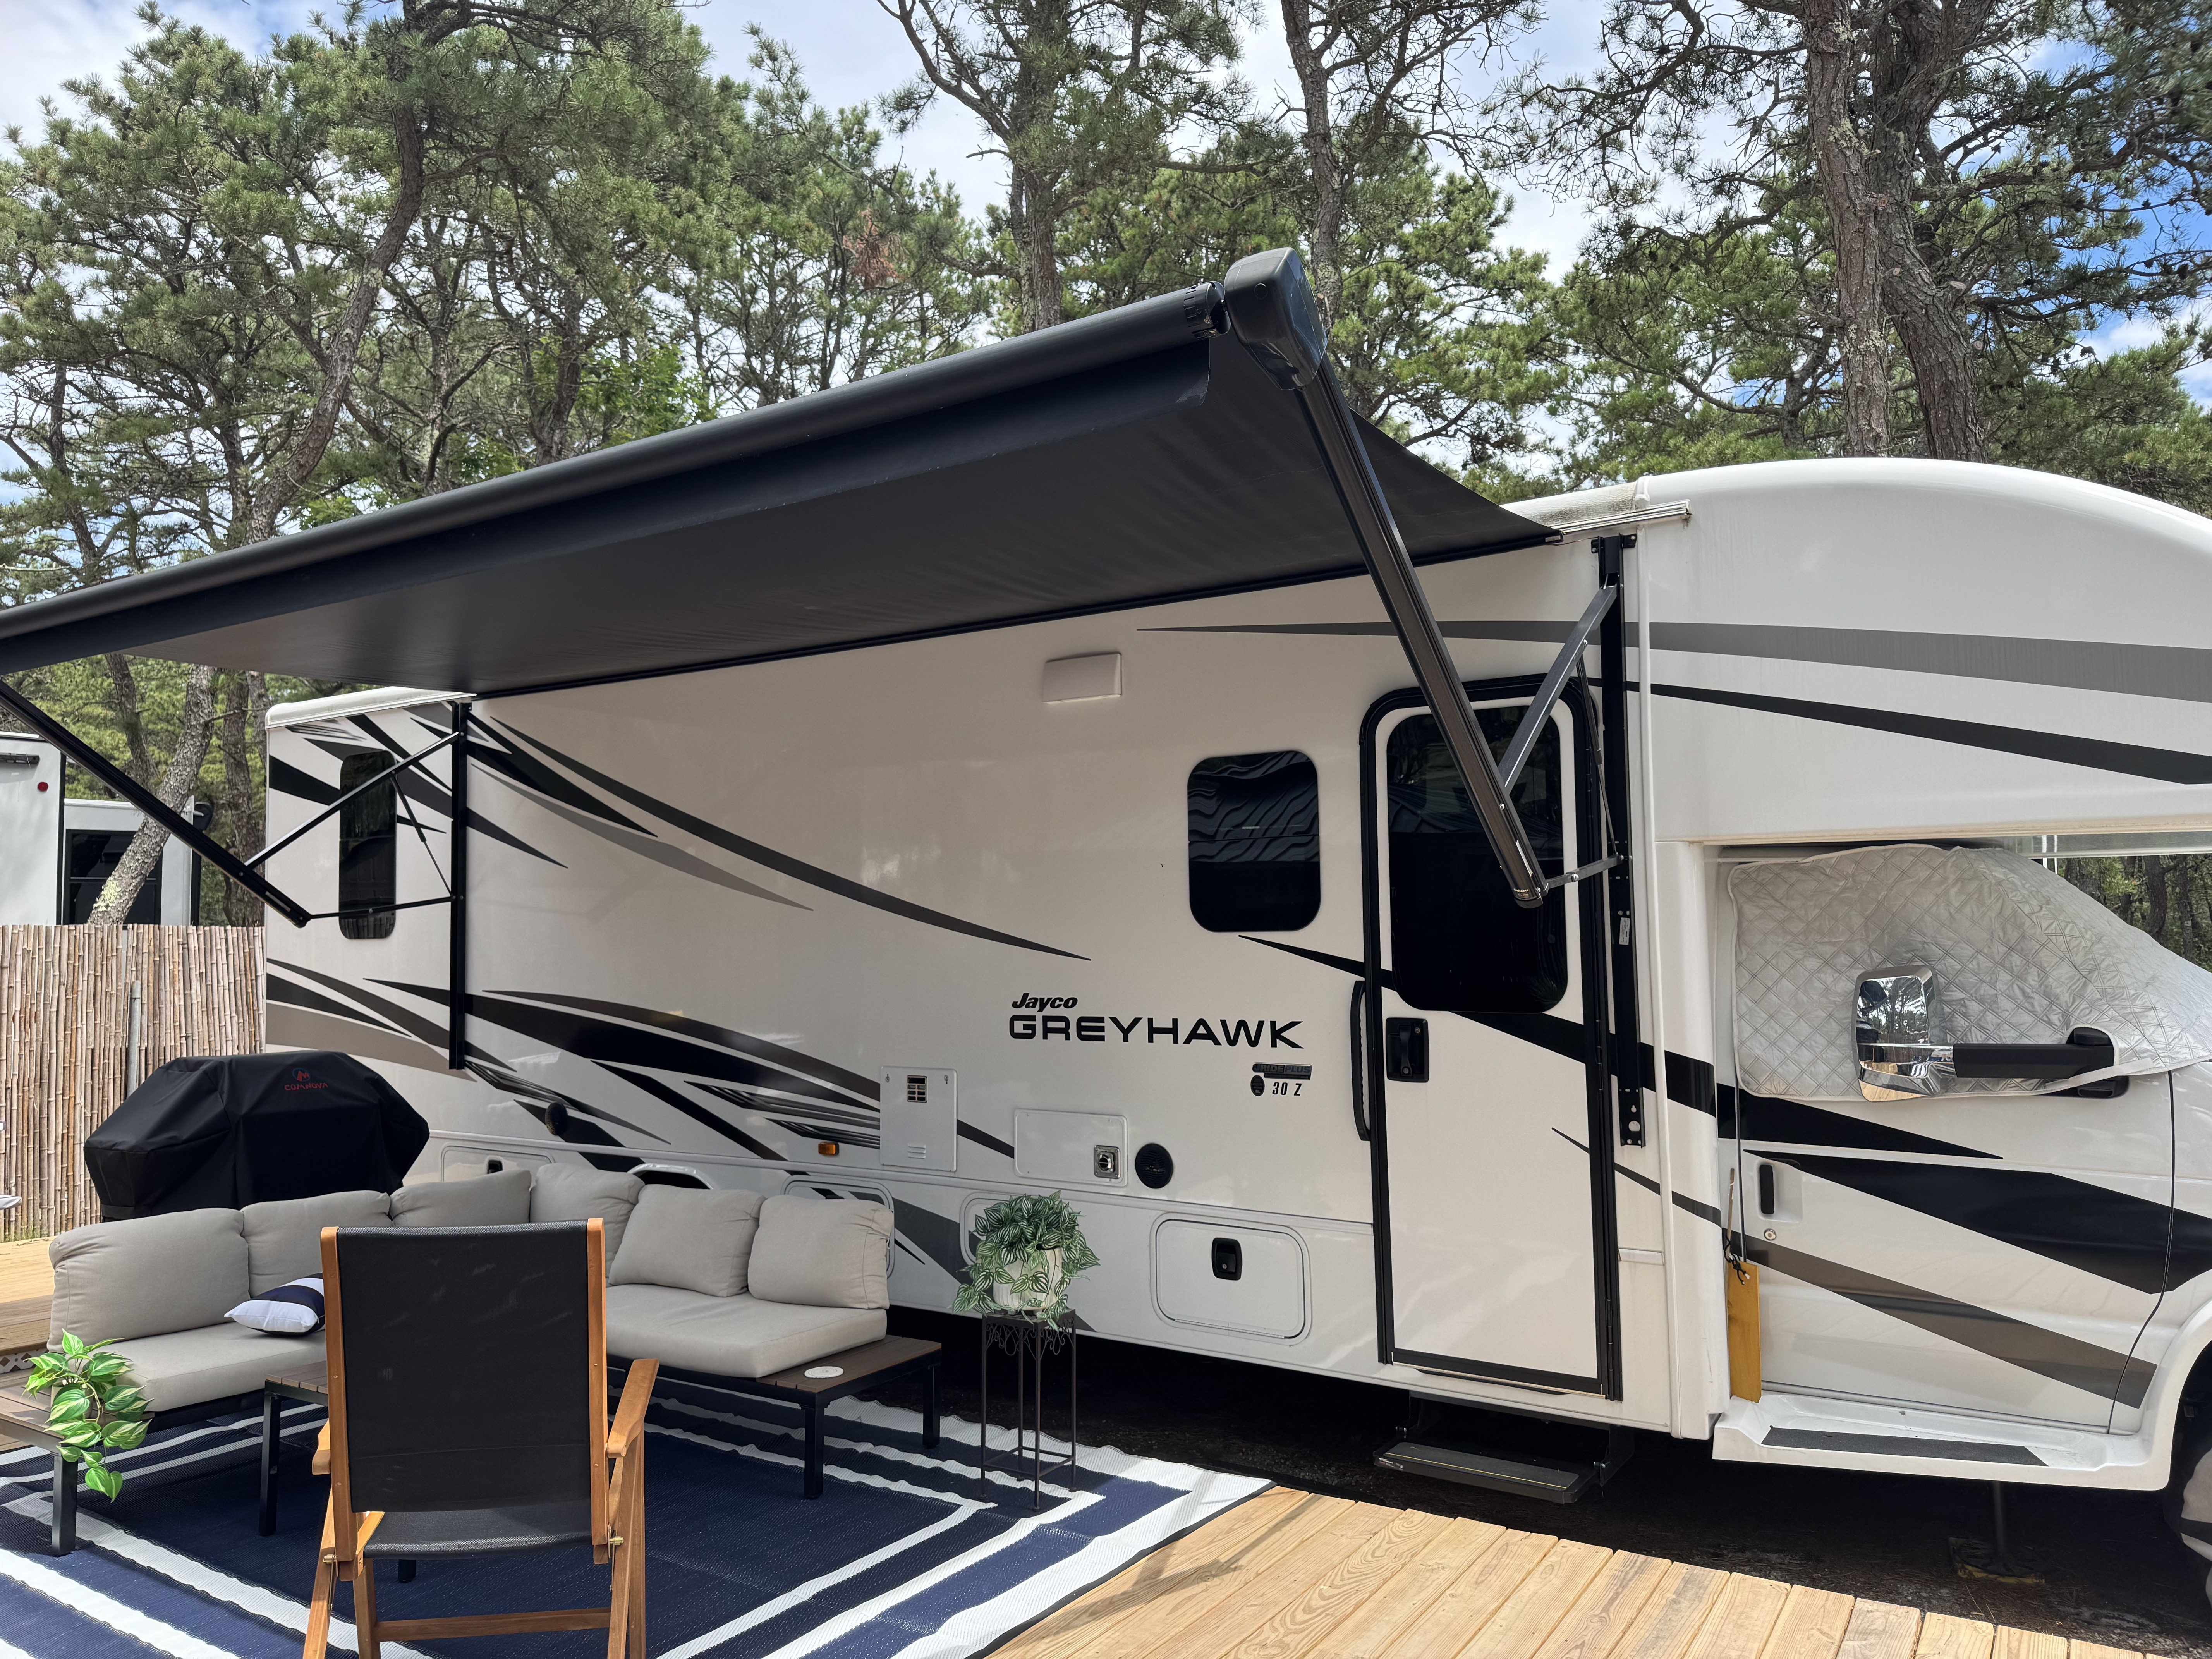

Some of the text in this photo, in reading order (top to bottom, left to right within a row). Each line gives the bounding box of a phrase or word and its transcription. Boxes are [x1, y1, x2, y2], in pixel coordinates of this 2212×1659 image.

[1012, 993, 1078, 1012] Jayco
[1009, 1015, 1304, 1049] GREYHAWK
[1272, 1082, 1288, 1095] 30
[1294, 1083, 1302, 1096] Z
